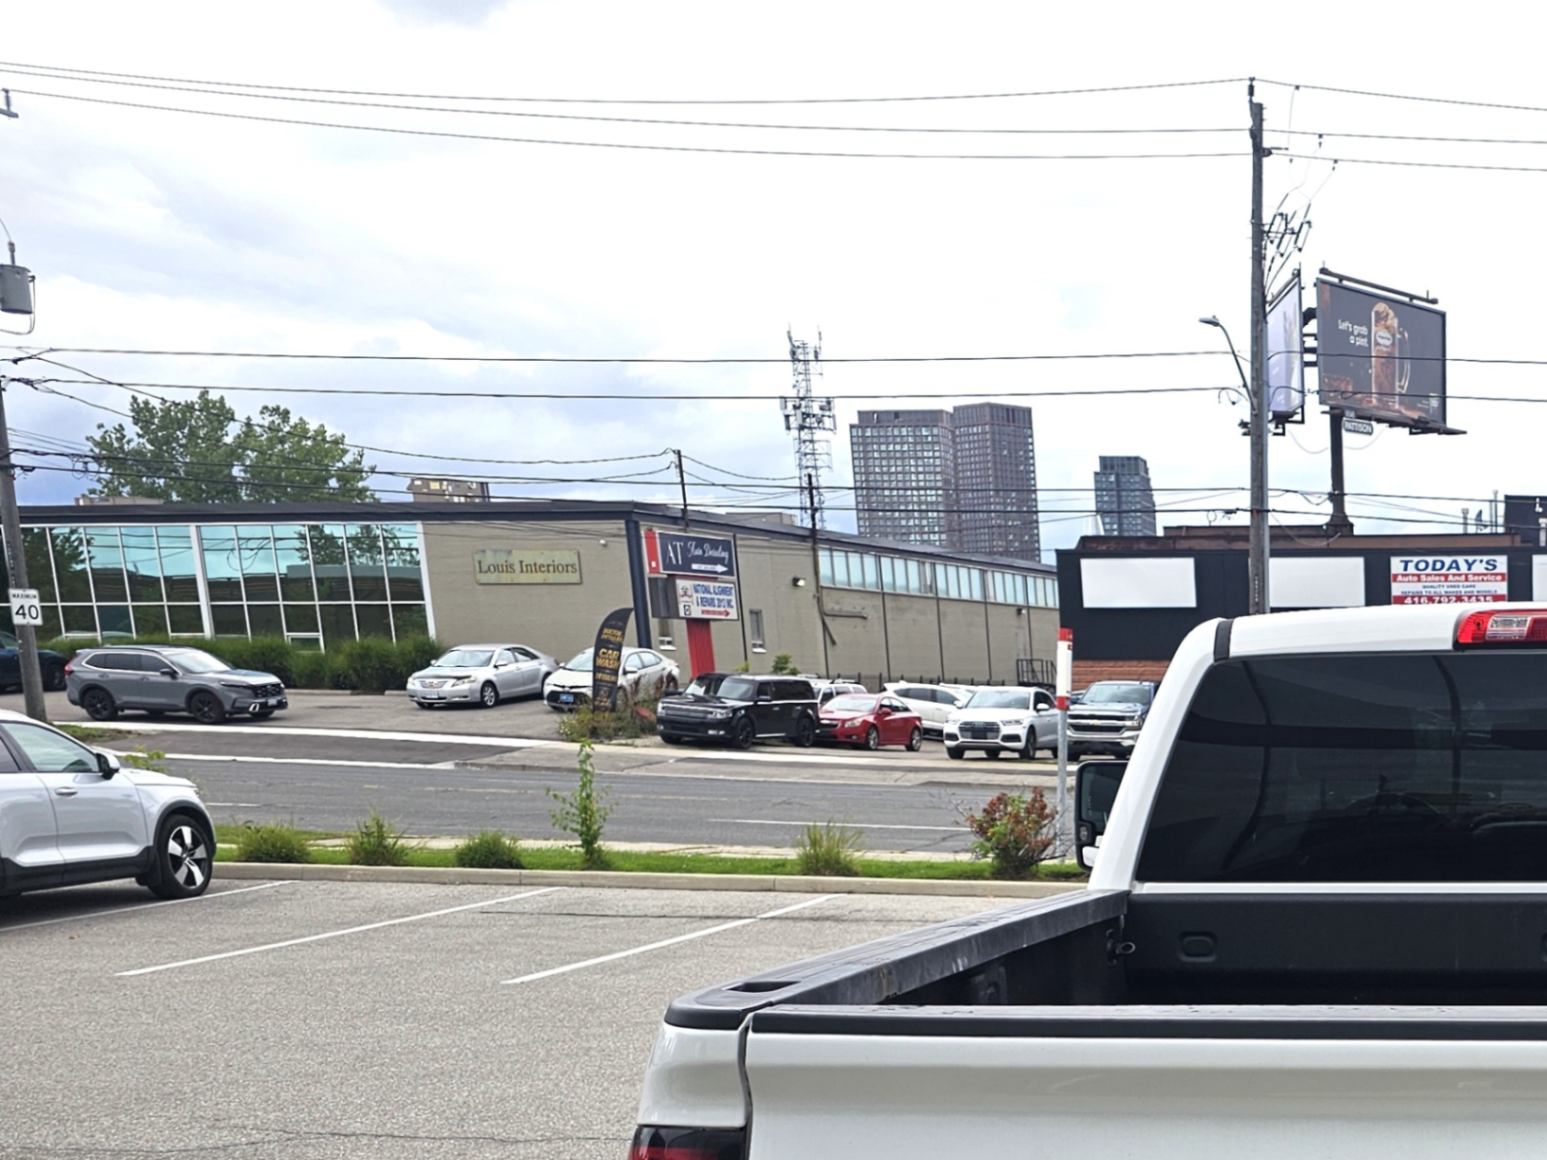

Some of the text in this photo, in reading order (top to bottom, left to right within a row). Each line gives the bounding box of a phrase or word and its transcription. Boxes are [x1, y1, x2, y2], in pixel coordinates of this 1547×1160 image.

[1344, 420, 1373, 433] PATTISON
[666, 541, 684, 565] AT
[478, 560, 578, 574] Louis Interiors
[1400, 559, 1498, 572] TODAY'S
[1420, 574, 1445, 582] Sales
[1447, 574, 1466, 582] And
[1468, 574, 1503, 582] Service
[15, 604, 39, 620] 40
[599, 648, 621, 658] CAR
